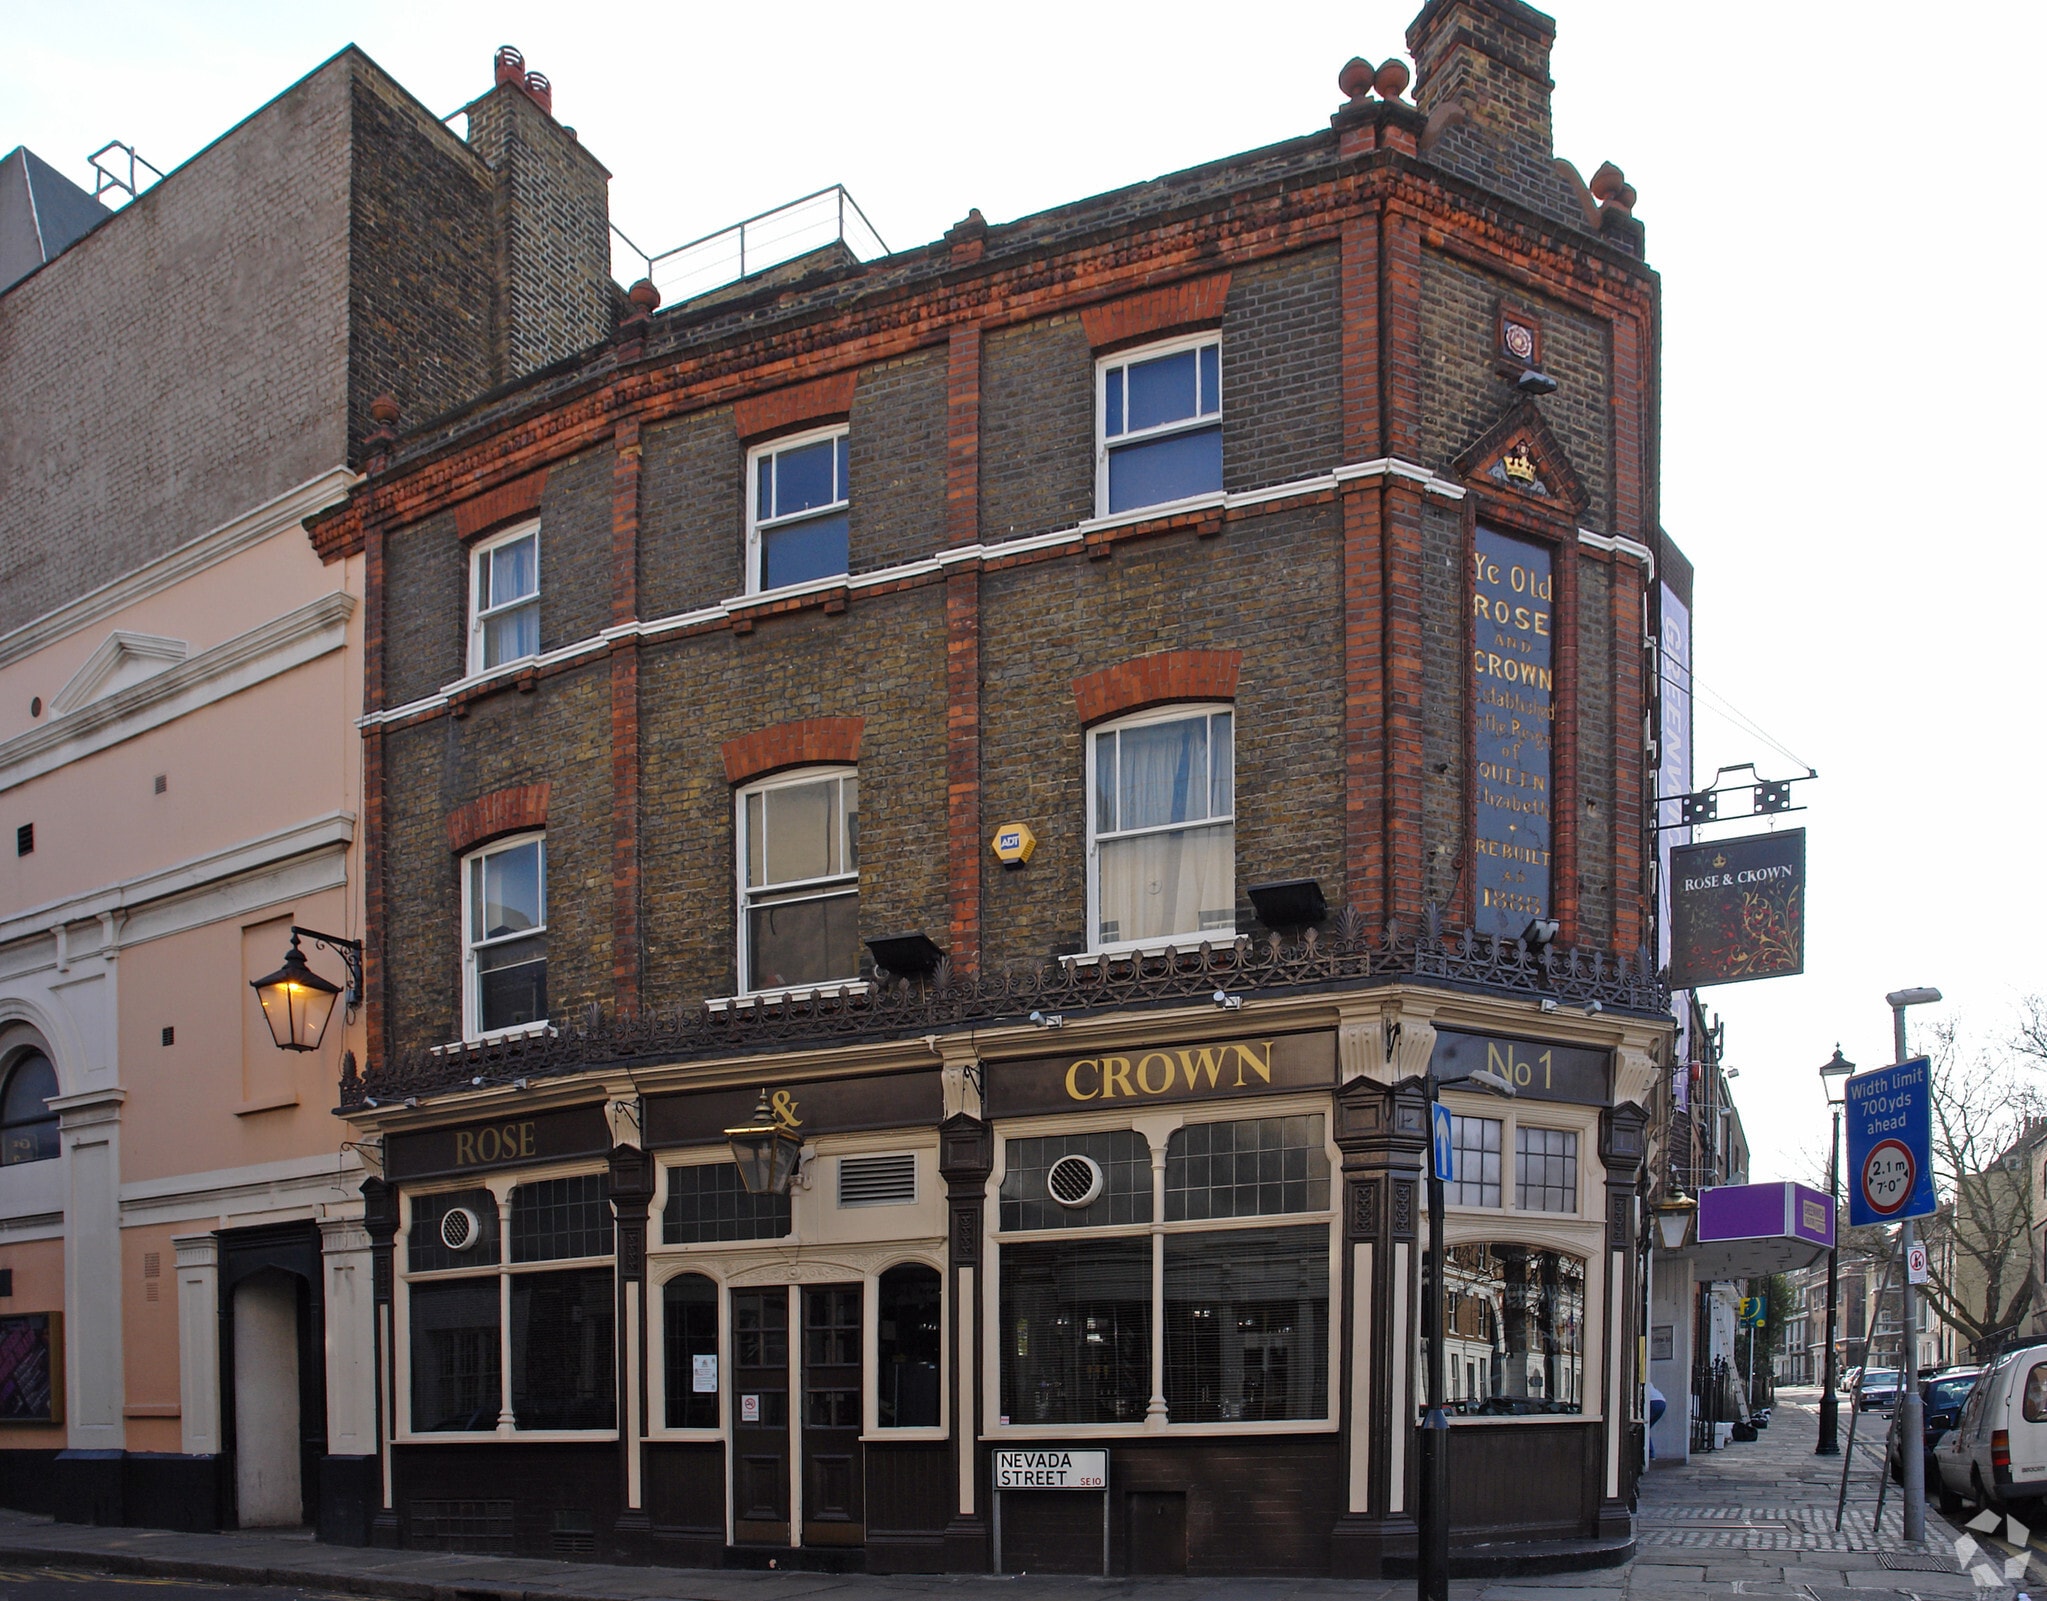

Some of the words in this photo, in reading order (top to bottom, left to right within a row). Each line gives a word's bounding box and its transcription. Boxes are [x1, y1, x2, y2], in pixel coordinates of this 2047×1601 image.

[1474, 552, 1500, 585] Ye
[1510, 564, 1553, 603] Old
[1473, 593, 1549, 636] ROSE
[1494, 633, 1533, 653] AND
[1474, 649, 1552, 692] CROWN
[1502, 743, 1520, 760] of
[1479, 761, 1546, 792] QUEEN
[1001, 836, 1020, 848] ADT
[1475, 837, 1552, 867] REBUILT
[1684, 874, 1720, 892] ROSE
[1722, 873, 1734, 886] &
[1737, 864, 1793, 884] CROWN
[1483, 886, 1542, 916] 1888
[1487, 1041, 1532, 1087] No
[1538, 1049, 1552, 1090] 1
[1850, 1078, 1888, 1100] Width
[1892, 1067, 1923, 1090] limit
[455, 1121, 537, 1166] ROSE
[771, 1090, 804, 1128] &
[1064, 1041, 1275, 1101] CROWN
[1867, 1111, 1907, 1135] ahead
[1001, 1453, 1072, 1468] NEVADA
[1001, 1470, 1067, 1486] STREET
